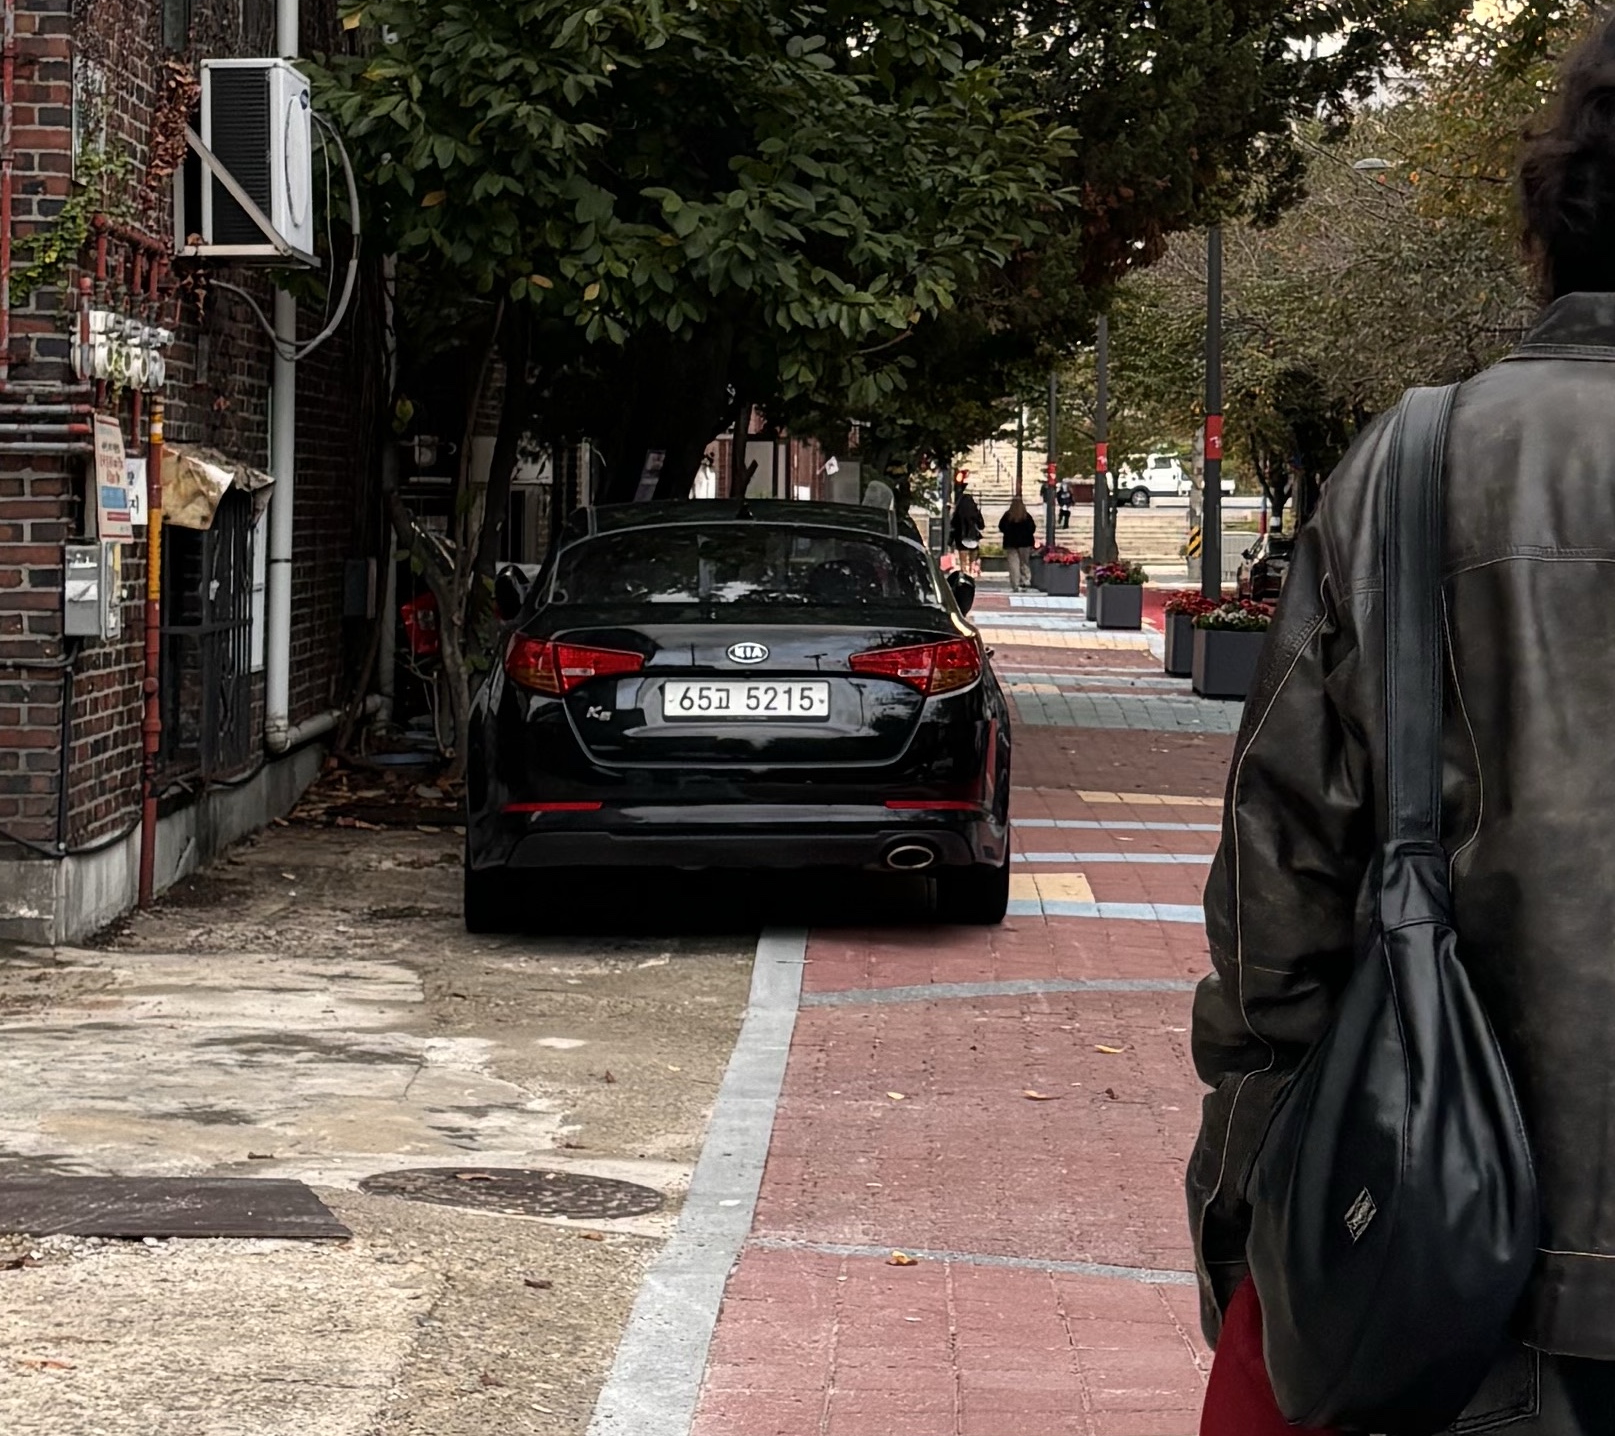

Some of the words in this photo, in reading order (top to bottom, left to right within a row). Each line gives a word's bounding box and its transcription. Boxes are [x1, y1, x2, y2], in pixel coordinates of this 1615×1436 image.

[734, 646, 763, 658] KIA
[679, 686, 731, 711] 65고
[746, 686, 814, 711] 5215
